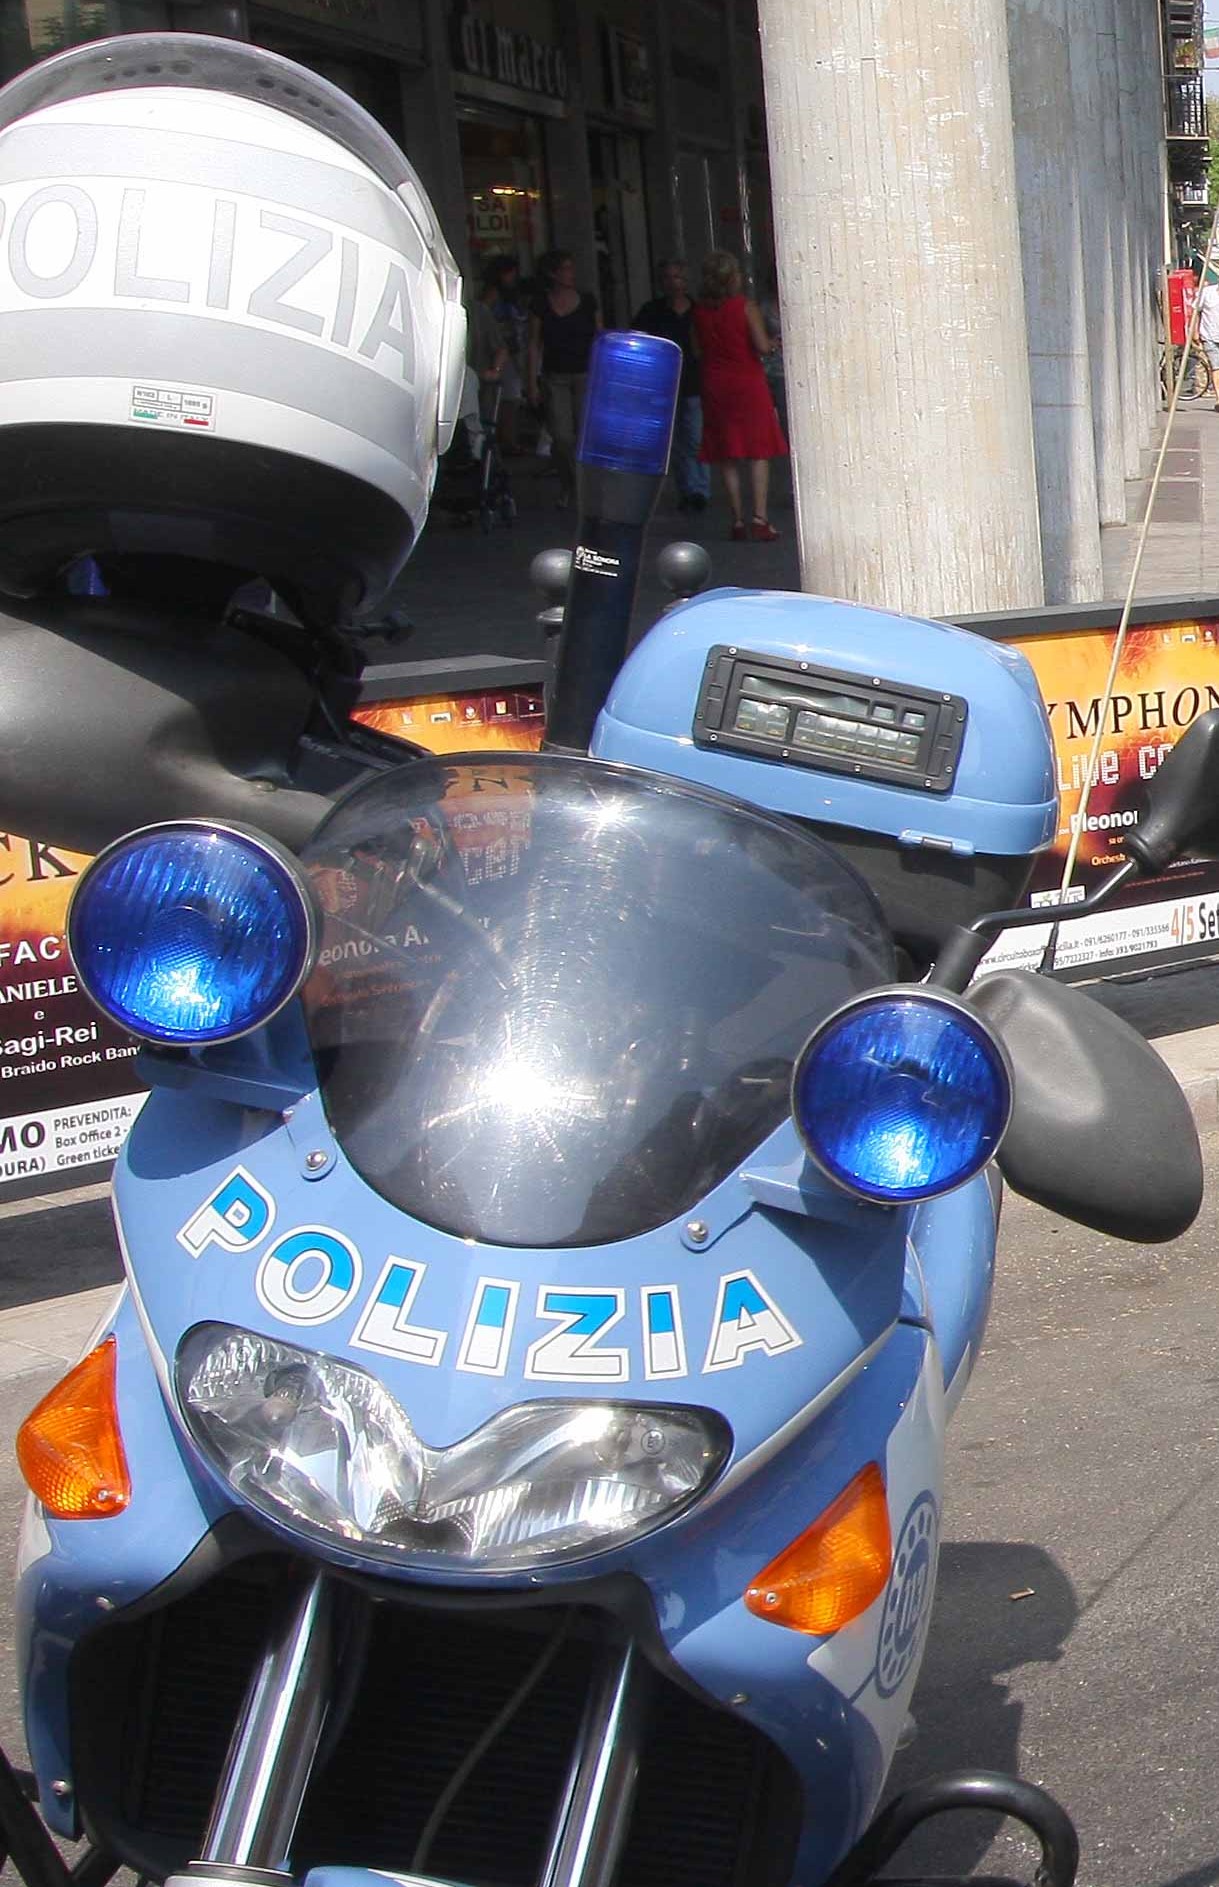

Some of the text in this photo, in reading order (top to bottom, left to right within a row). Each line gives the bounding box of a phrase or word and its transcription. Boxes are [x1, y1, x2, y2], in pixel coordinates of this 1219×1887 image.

[0, 184, 416, 386] OLIZIA
[1047, 686, 1219, 740] MPHO
[1171, 904, 1195, 946] 4/5
[34, 1010, 45, 1020] e
[0, 1022, 97, 1057] agi-Rei
[1, 1058, 57, 1079] Braido
[60, 1051, 102, 1069] Rock
[54, 1106, 132, 1132] PREVENDITA:
[55, 1136, 77, 1149] Box
[79, 1128, 112, 1145] Office
[114, 1126, 121, 1138] 2
[0, 1156, 46, 1179] URA)
[57, 1152, 91, 1167] Green
[176, 1164, 803, 1382] POLIZIA
